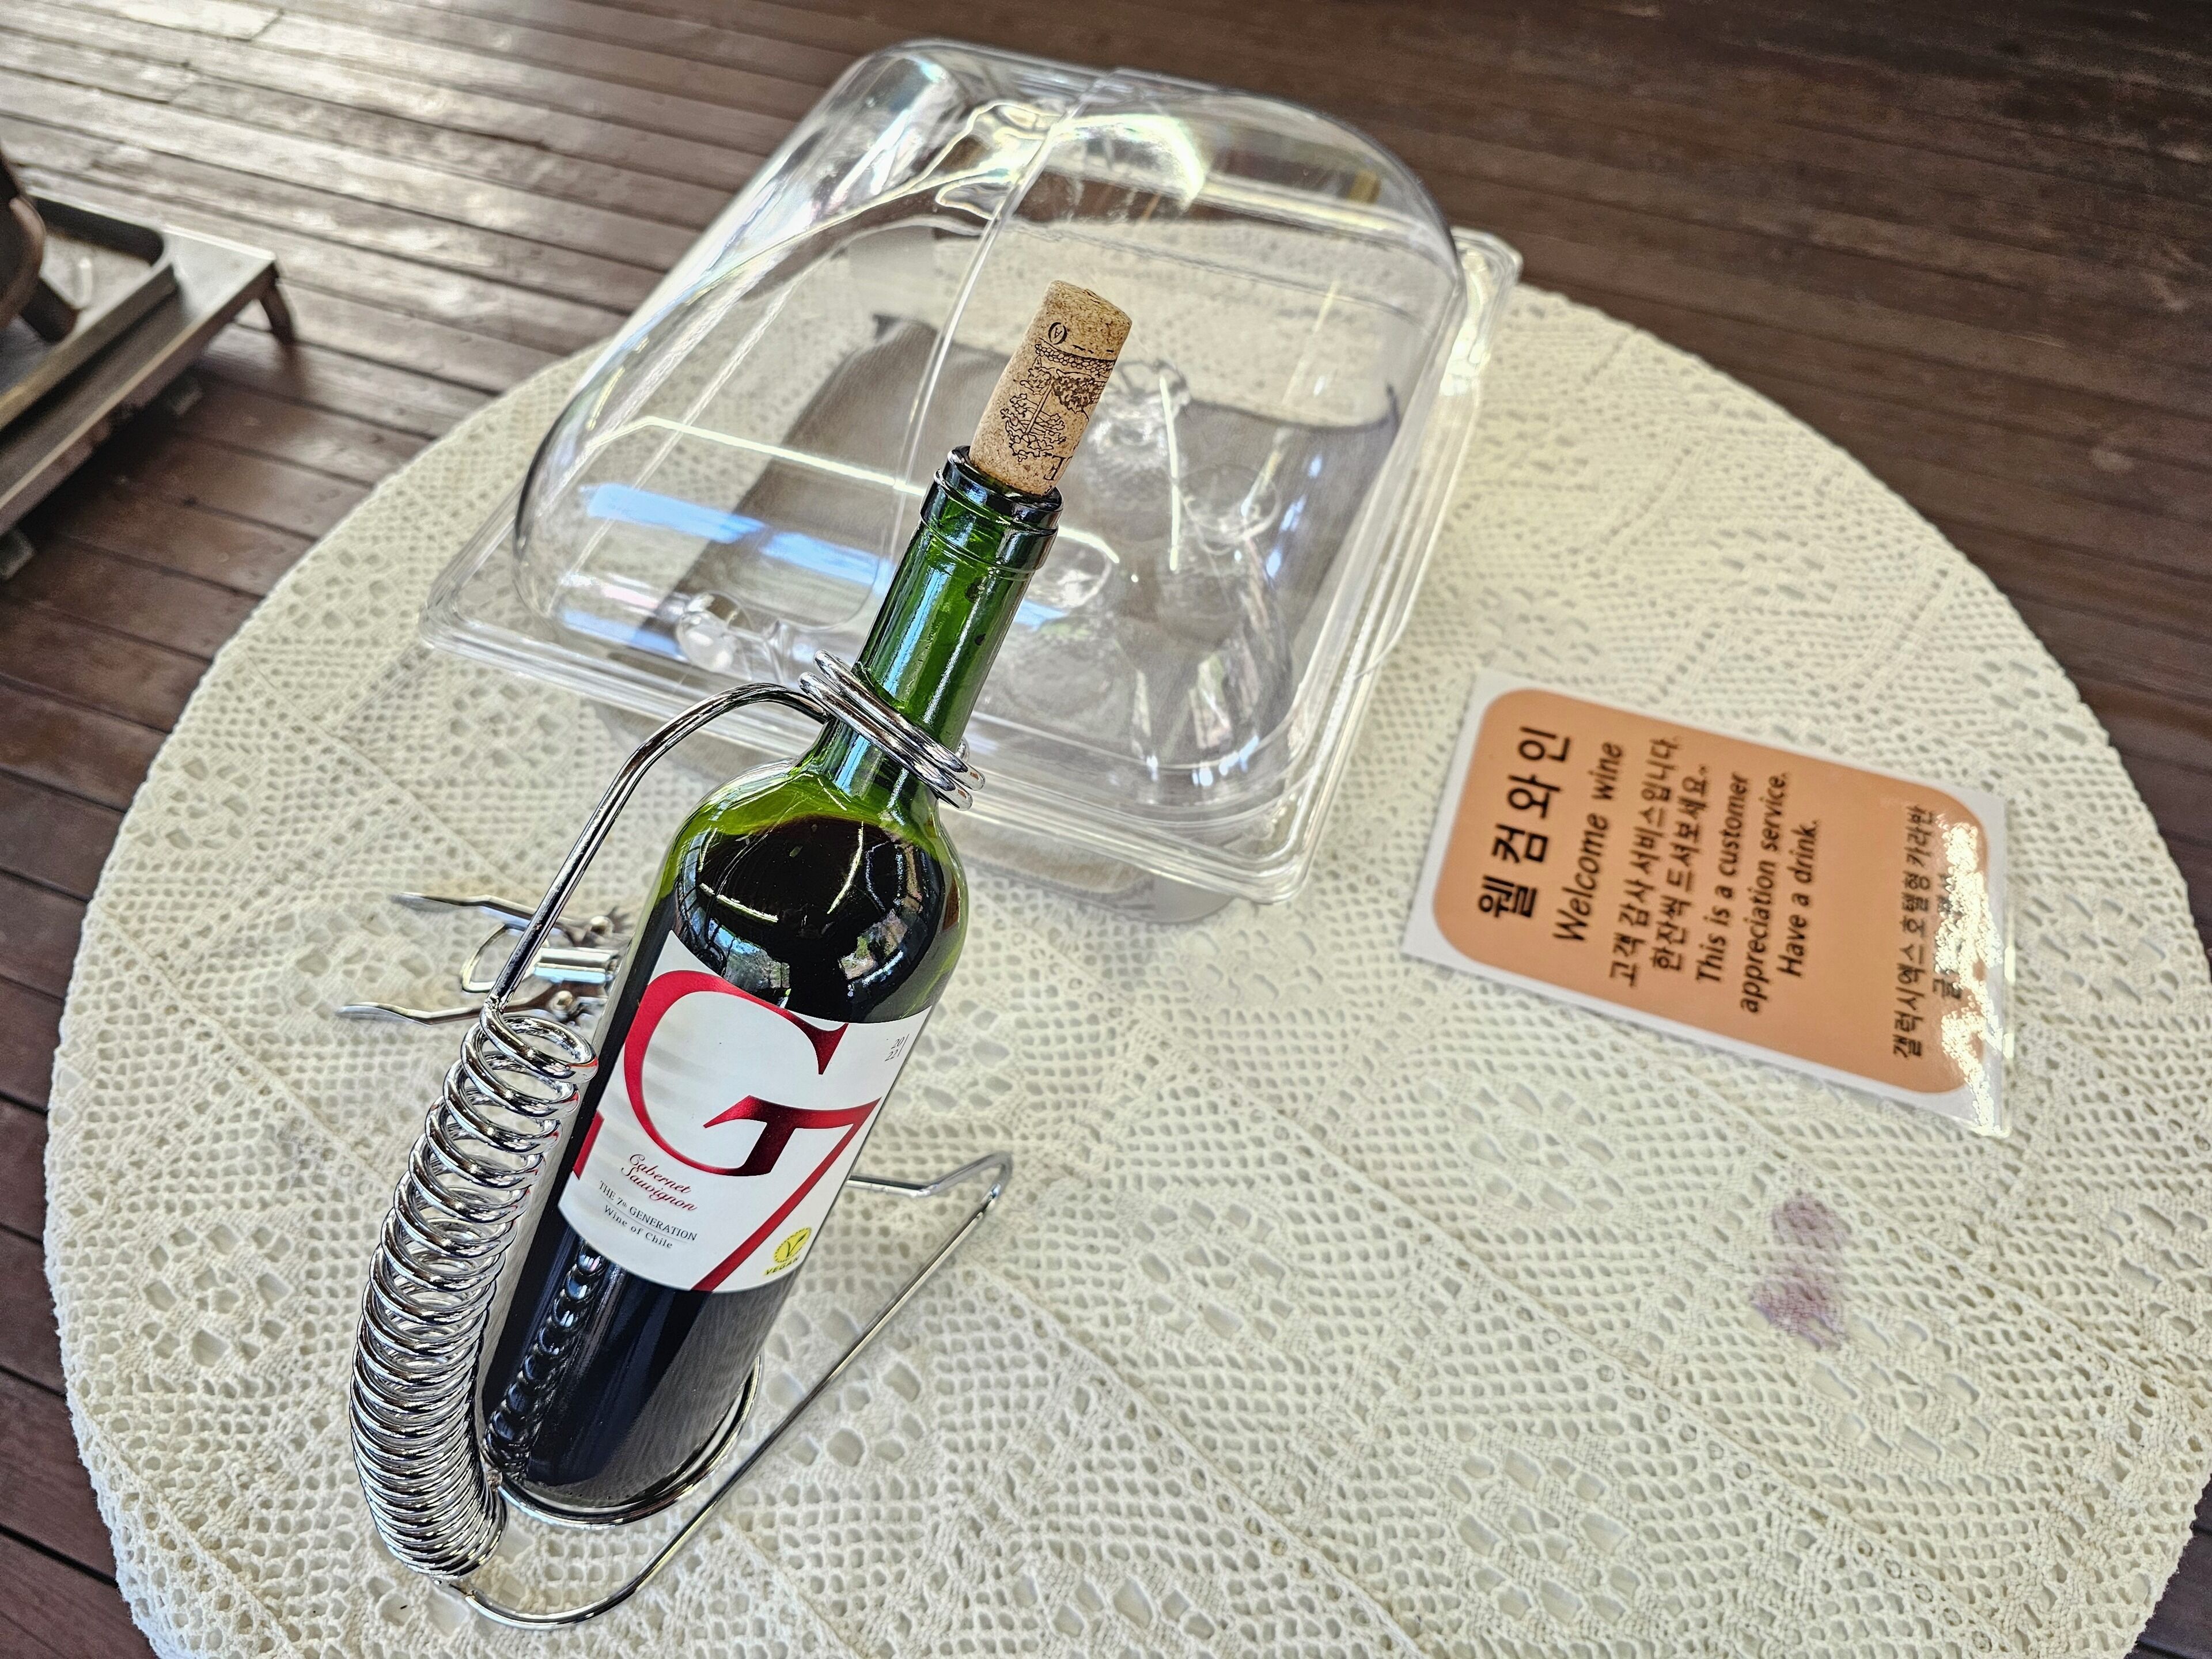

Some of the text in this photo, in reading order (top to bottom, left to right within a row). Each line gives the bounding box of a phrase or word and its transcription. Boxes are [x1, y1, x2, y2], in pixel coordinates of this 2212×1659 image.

[1552, 741, 1623, 941] Welcome wine
[1618, 878, 1656, 926] 감사
[1696, 771, 1749, 984] This is a customer
[1740, 772, 1788, 1014] appreciation service.
[1777, 819, 1819, 977] Have a drink.
[1609, 933, 1646, 988] 고객
[1650, 895, 1692, 972] 한잔씩
[1892, 805, 1934, 1058] 갤럭시엑스 호텔형 카라반
[621, 1167, 698, 1211] Sauvignon
[630, 1154, 691, 1194] Cabernet
[599, 1180, 616, 1200] THE
[630, 1206, 698, 1241] GENERATION
[605, 1205, 673, 1249] Wine of Chile
[765, 1255, 800, 1275] VEGAN
